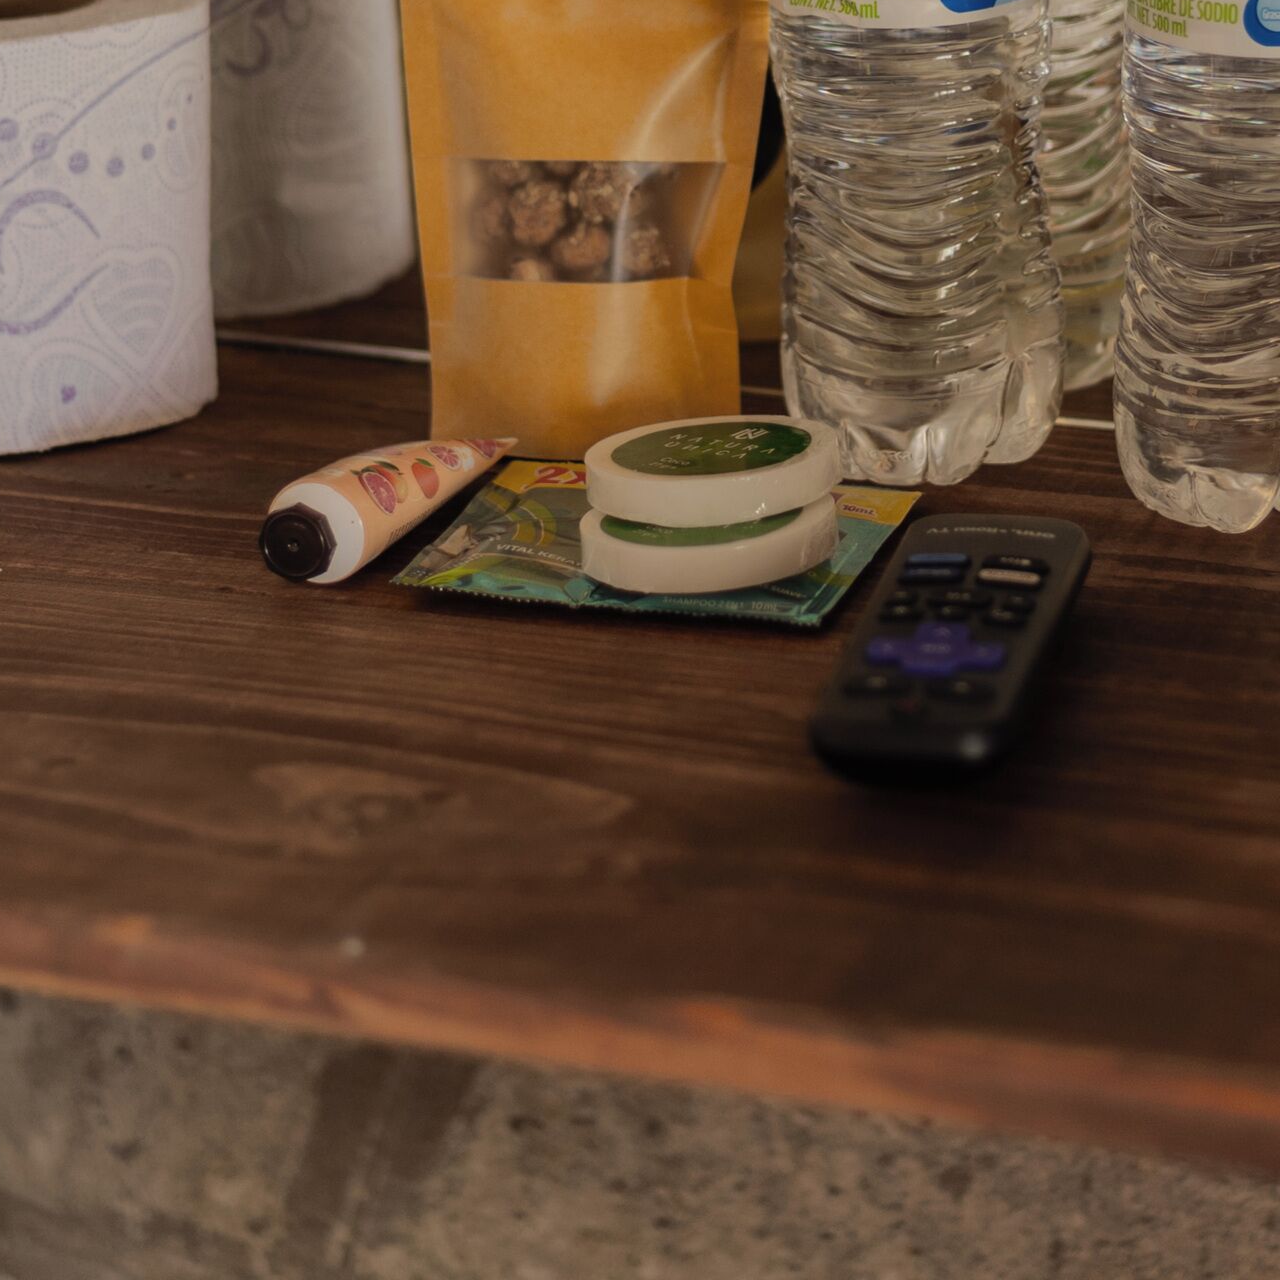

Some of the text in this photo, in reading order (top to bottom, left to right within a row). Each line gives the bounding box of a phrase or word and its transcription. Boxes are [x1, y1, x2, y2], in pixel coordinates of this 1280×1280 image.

[1152, 12, 1170, 33] 500
[1197, 0, 1239, 25] SODIO
[664, 441, 747, 459] UNICA
[670, 433, 776, 455] NATURA
[496, 543, 535, 555] VITAL
